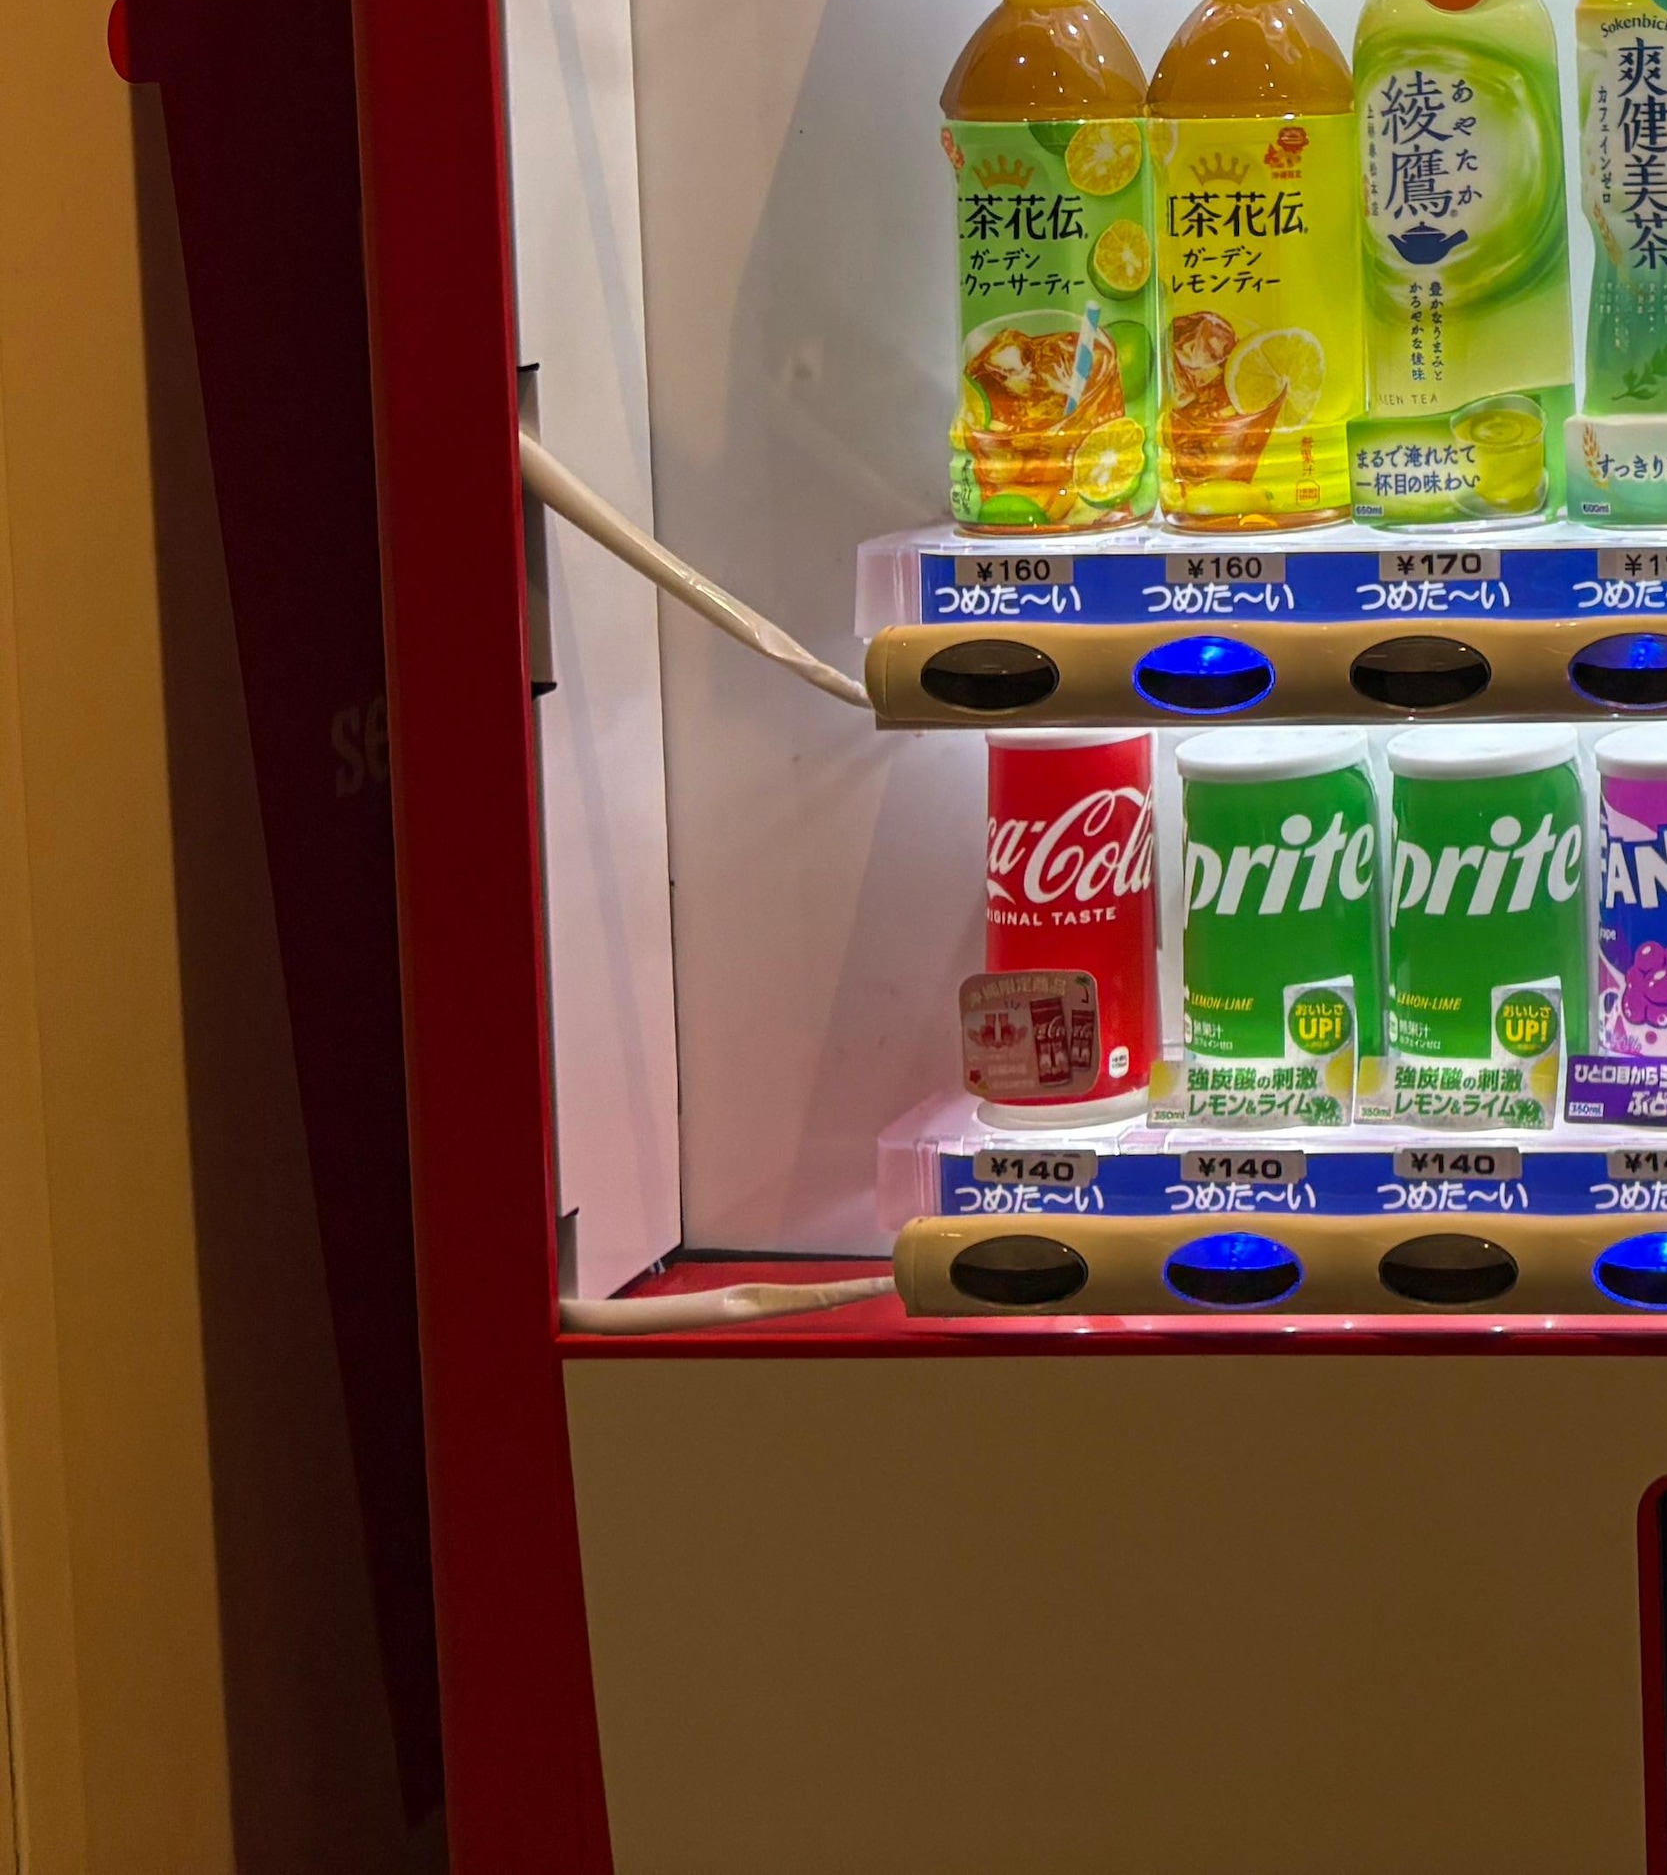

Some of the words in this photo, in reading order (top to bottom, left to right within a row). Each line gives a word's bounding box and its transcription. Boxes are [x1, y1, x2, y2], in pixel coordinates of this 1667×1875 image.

[1380, 70, 1453, 221] 綾鷹
[1452, 79, 1484, 206] あやたか
[958, 194, 1085, 240] 茶花伝
[1182, 247, 1263, 269] ガーデン
[1171, 273, 1281, 295] レモンティー
[1356, 444, 1476, 470] まるで淹れたて
[977, 559, 1050, 582] ¥160
[1188, 557, 1262, 580] ¥160
[1183, 811, 1377, 917] prite
[1298, 1016, 1343, 1041] UP!
[1188, 1067, 1318, 1091] 強炭酸の刺激
[1198, 1156, 1284, 1179] ¥140
[1409, 1151, 1498, 1175] ¥140
